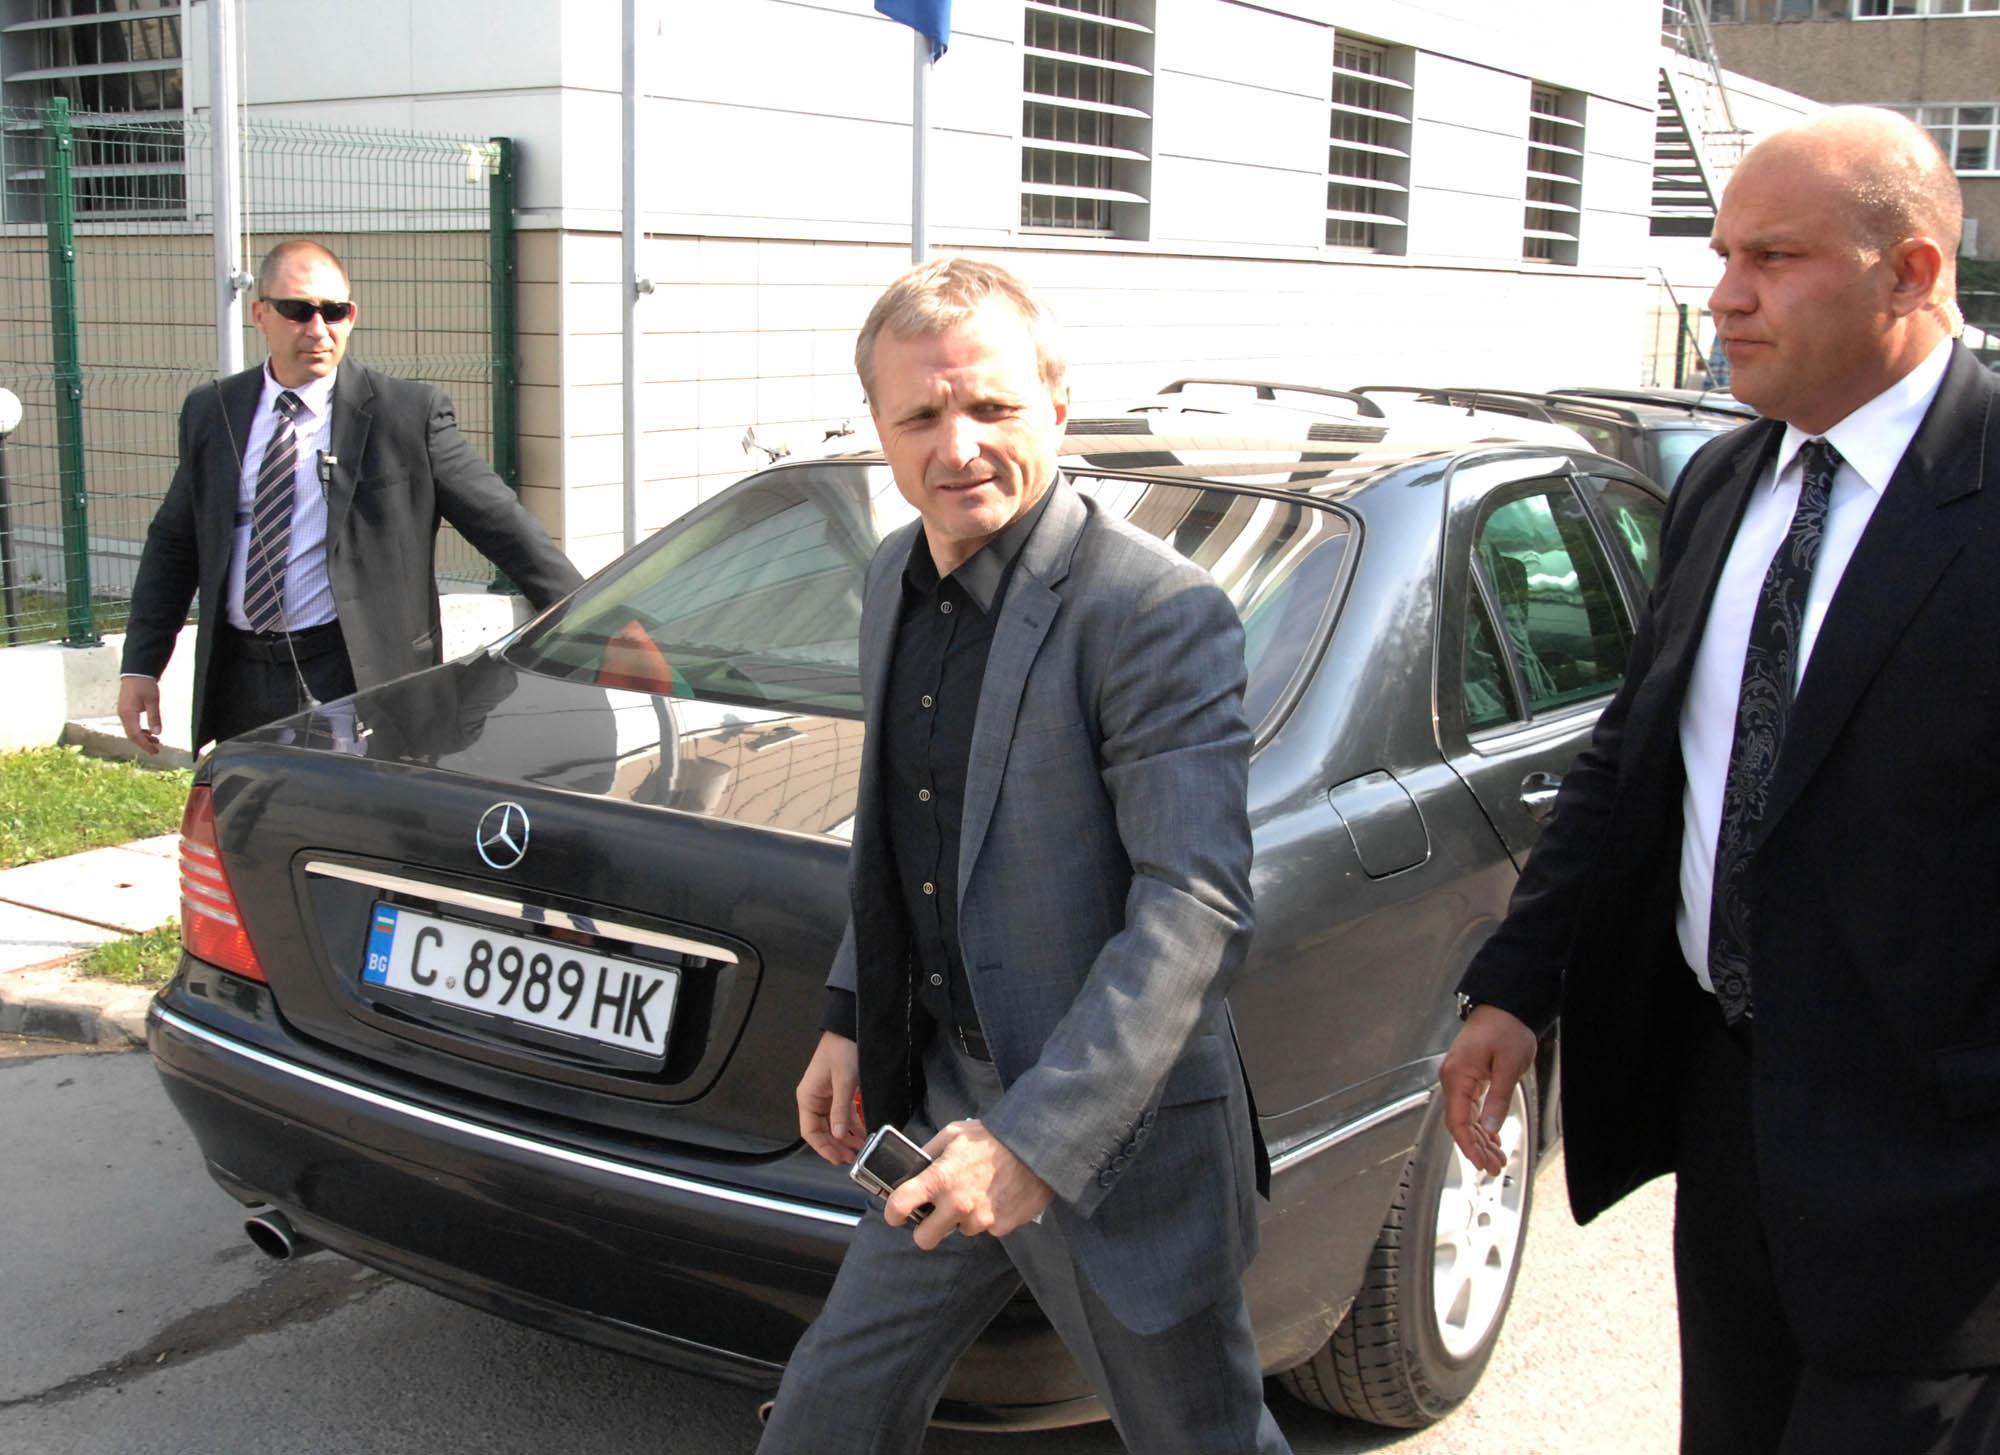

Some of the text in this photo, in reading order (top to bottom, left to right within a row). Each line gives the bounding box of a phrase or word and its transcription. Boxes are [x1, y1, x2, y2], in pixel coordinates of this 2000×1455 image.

[368, 952, 388, 973] BG
[410, 926, 664, 1044] C 8989 HK
